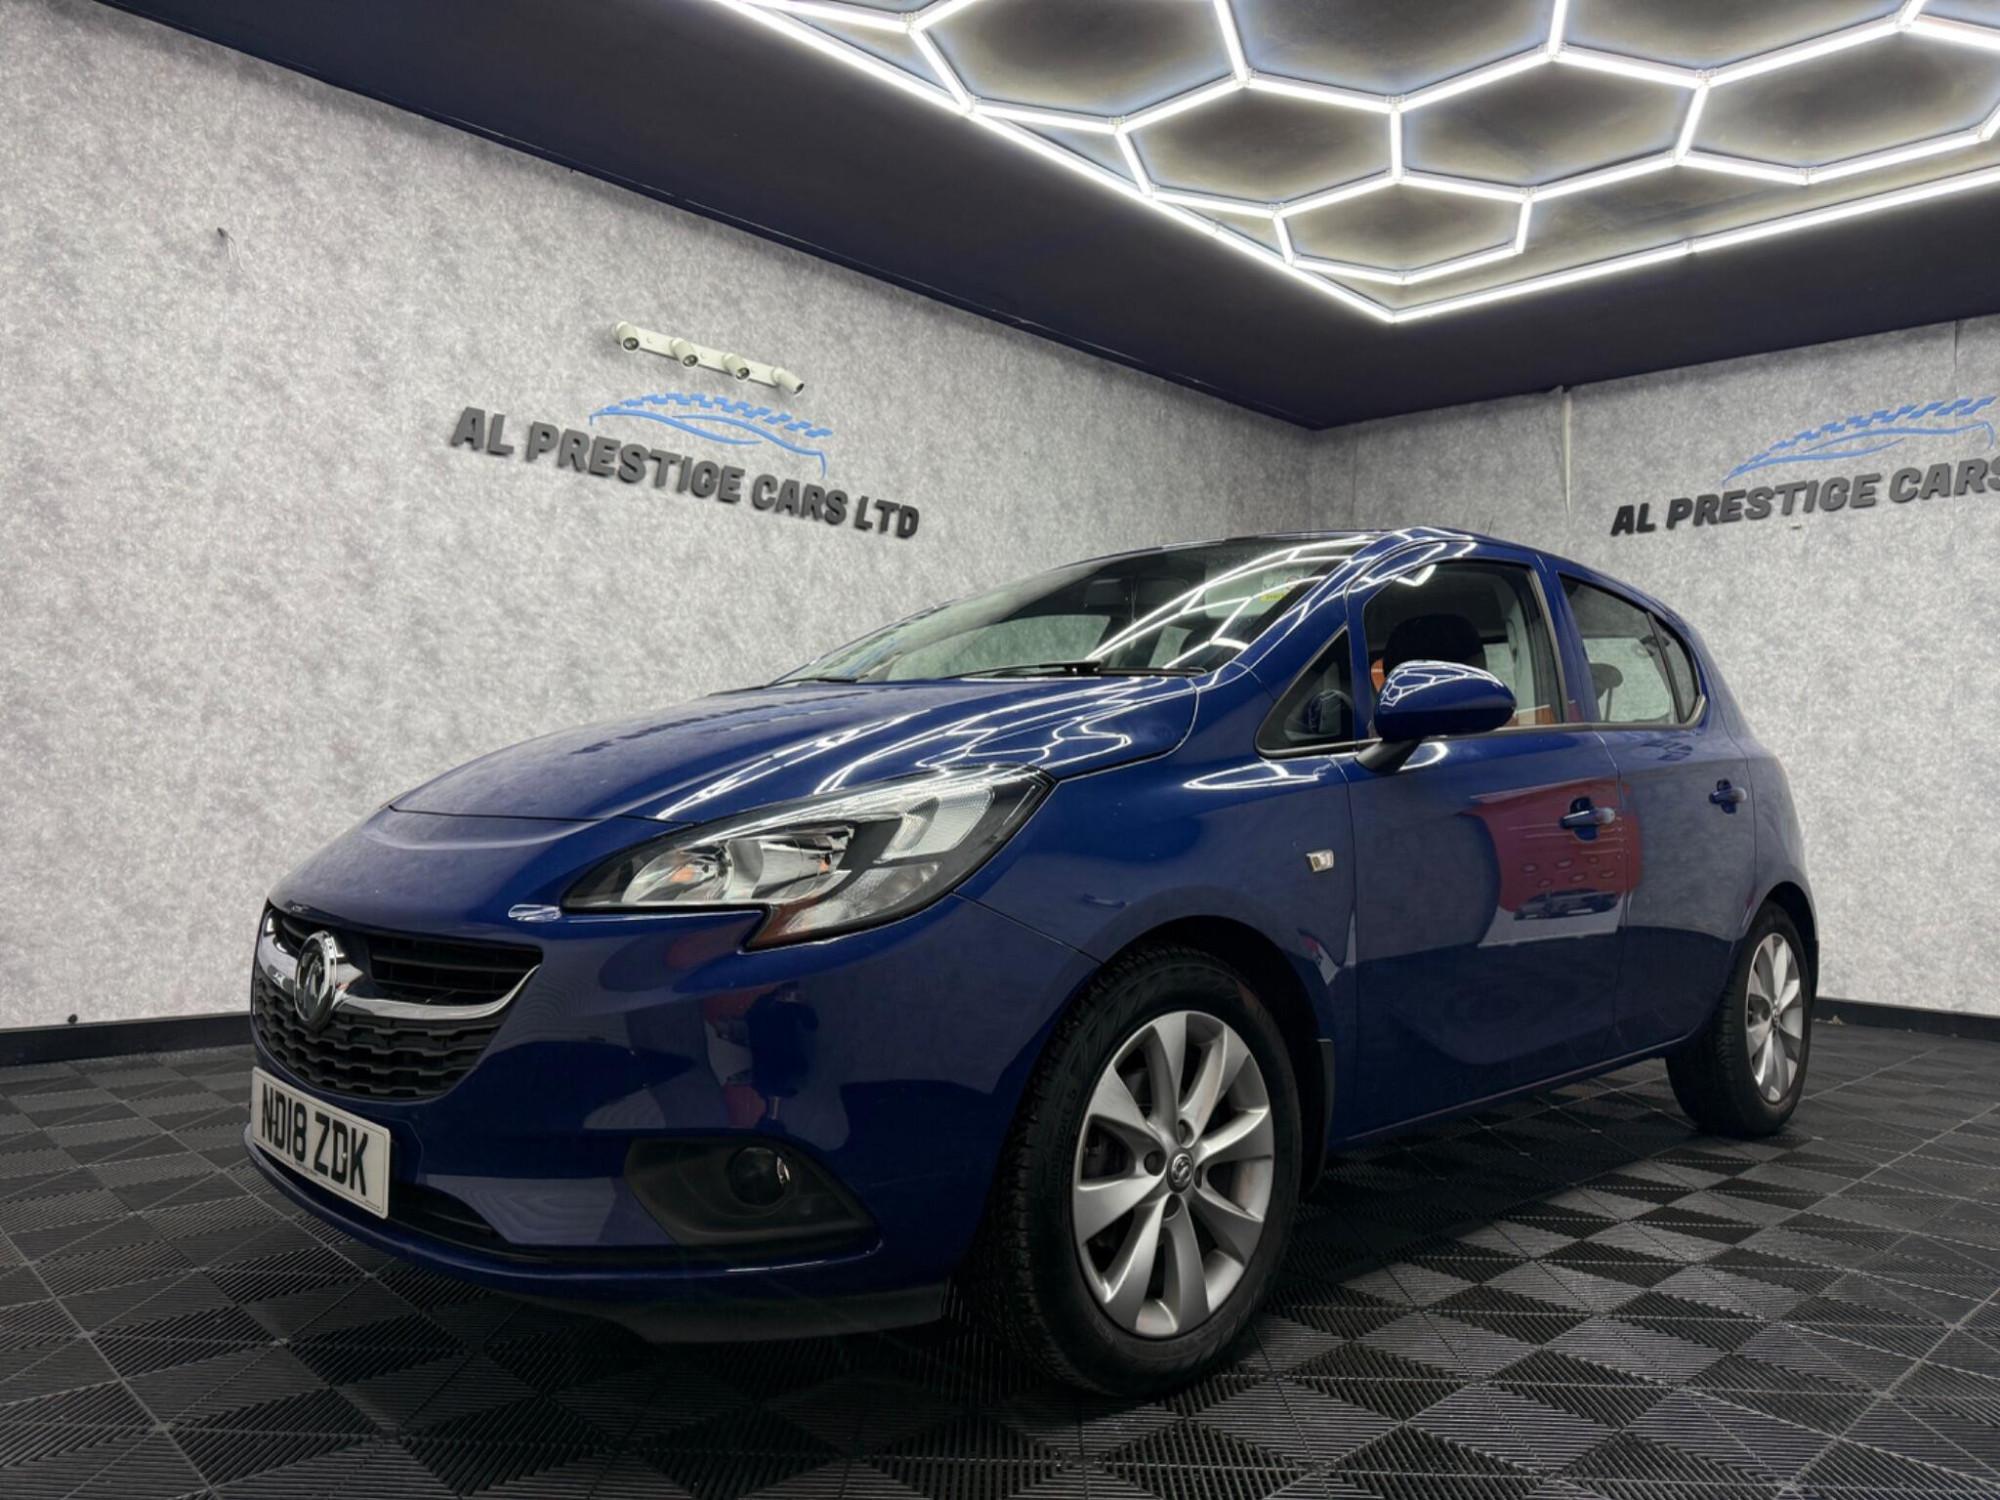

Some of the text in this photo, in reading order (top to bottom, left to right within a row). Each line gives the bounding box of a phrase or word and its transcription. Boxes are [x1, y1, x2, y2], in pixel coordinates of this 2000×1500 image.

[451, 407, 920, 539] AL PRESTIGE CARS LTD
[1610, 503, 1656, 536] AL
[1666, 473, 1881, 530] PRESTIGE
[261, 1083, 369, 1197] ND18 ZDK
